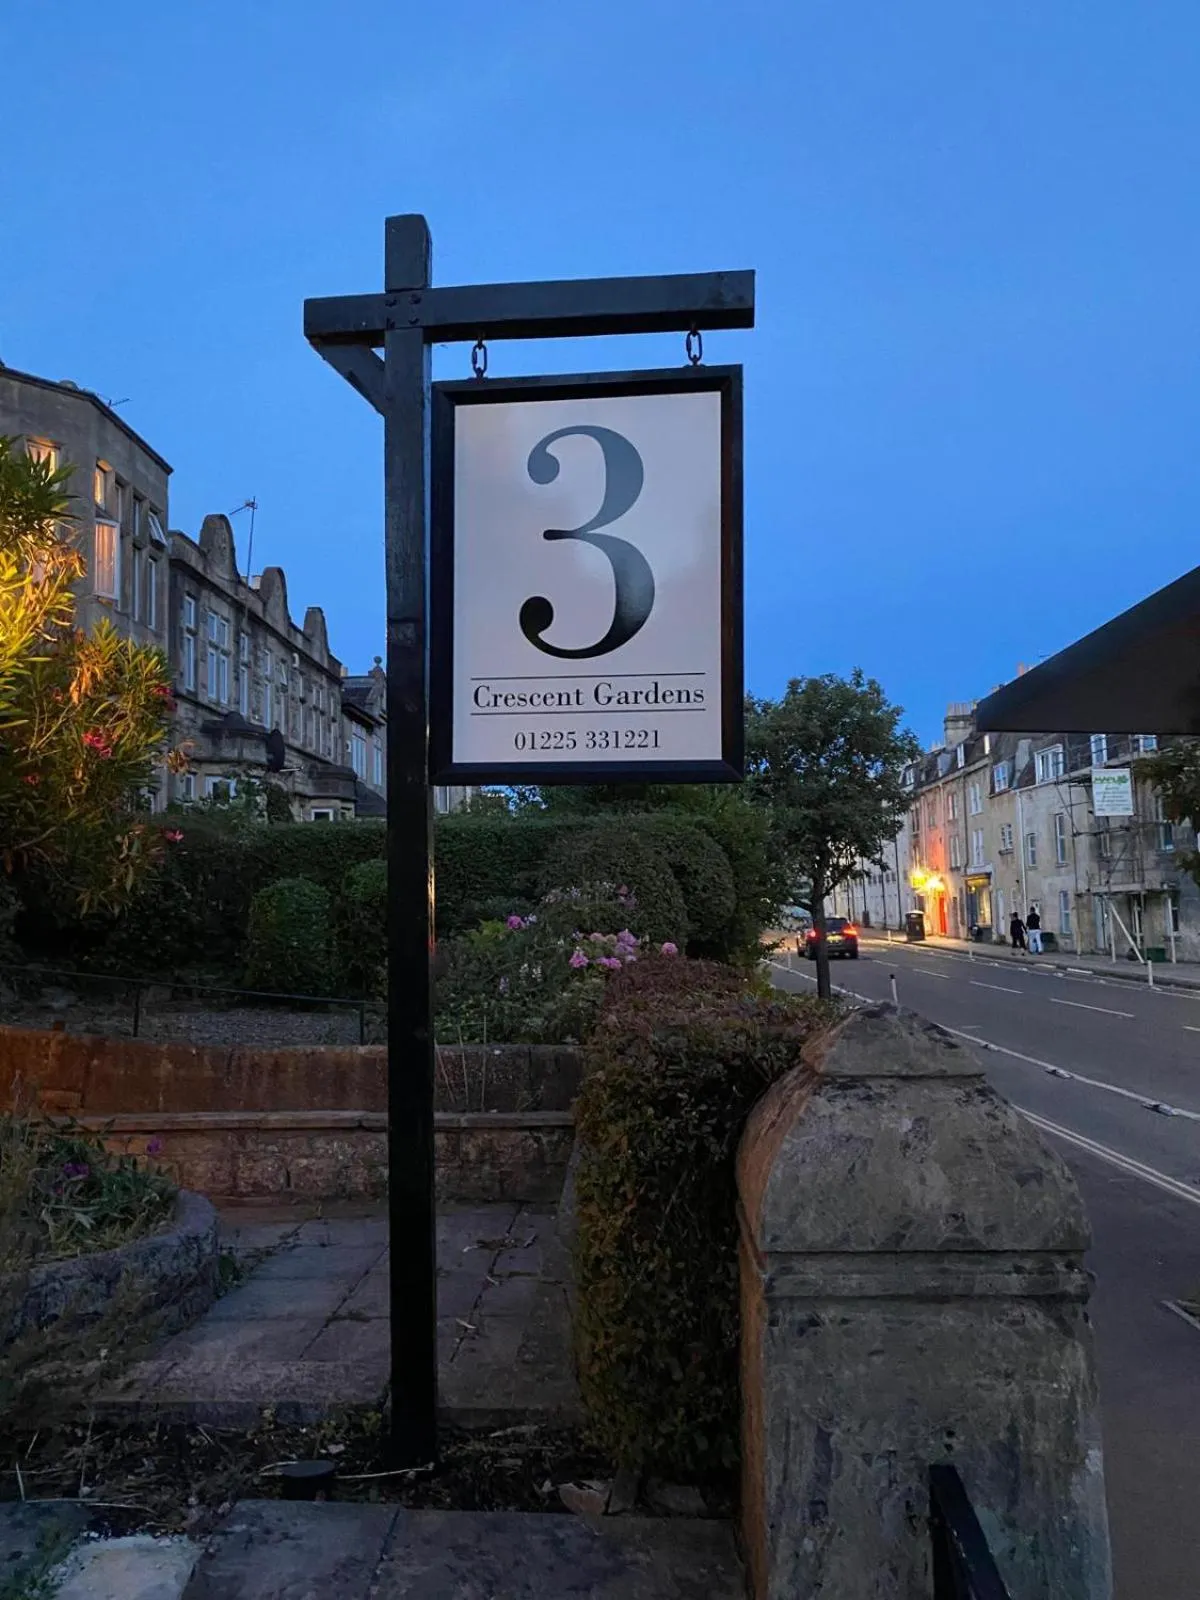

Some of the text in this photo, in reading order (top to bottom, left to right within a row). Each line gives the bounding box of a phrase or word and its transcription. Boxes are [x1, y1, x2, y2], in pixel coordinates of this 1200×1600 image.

[519, 425, 656, 659] 3
[473, 681, 705, 708] Crescent Gardens
[513, 729, 661, 750] 01225 331221
